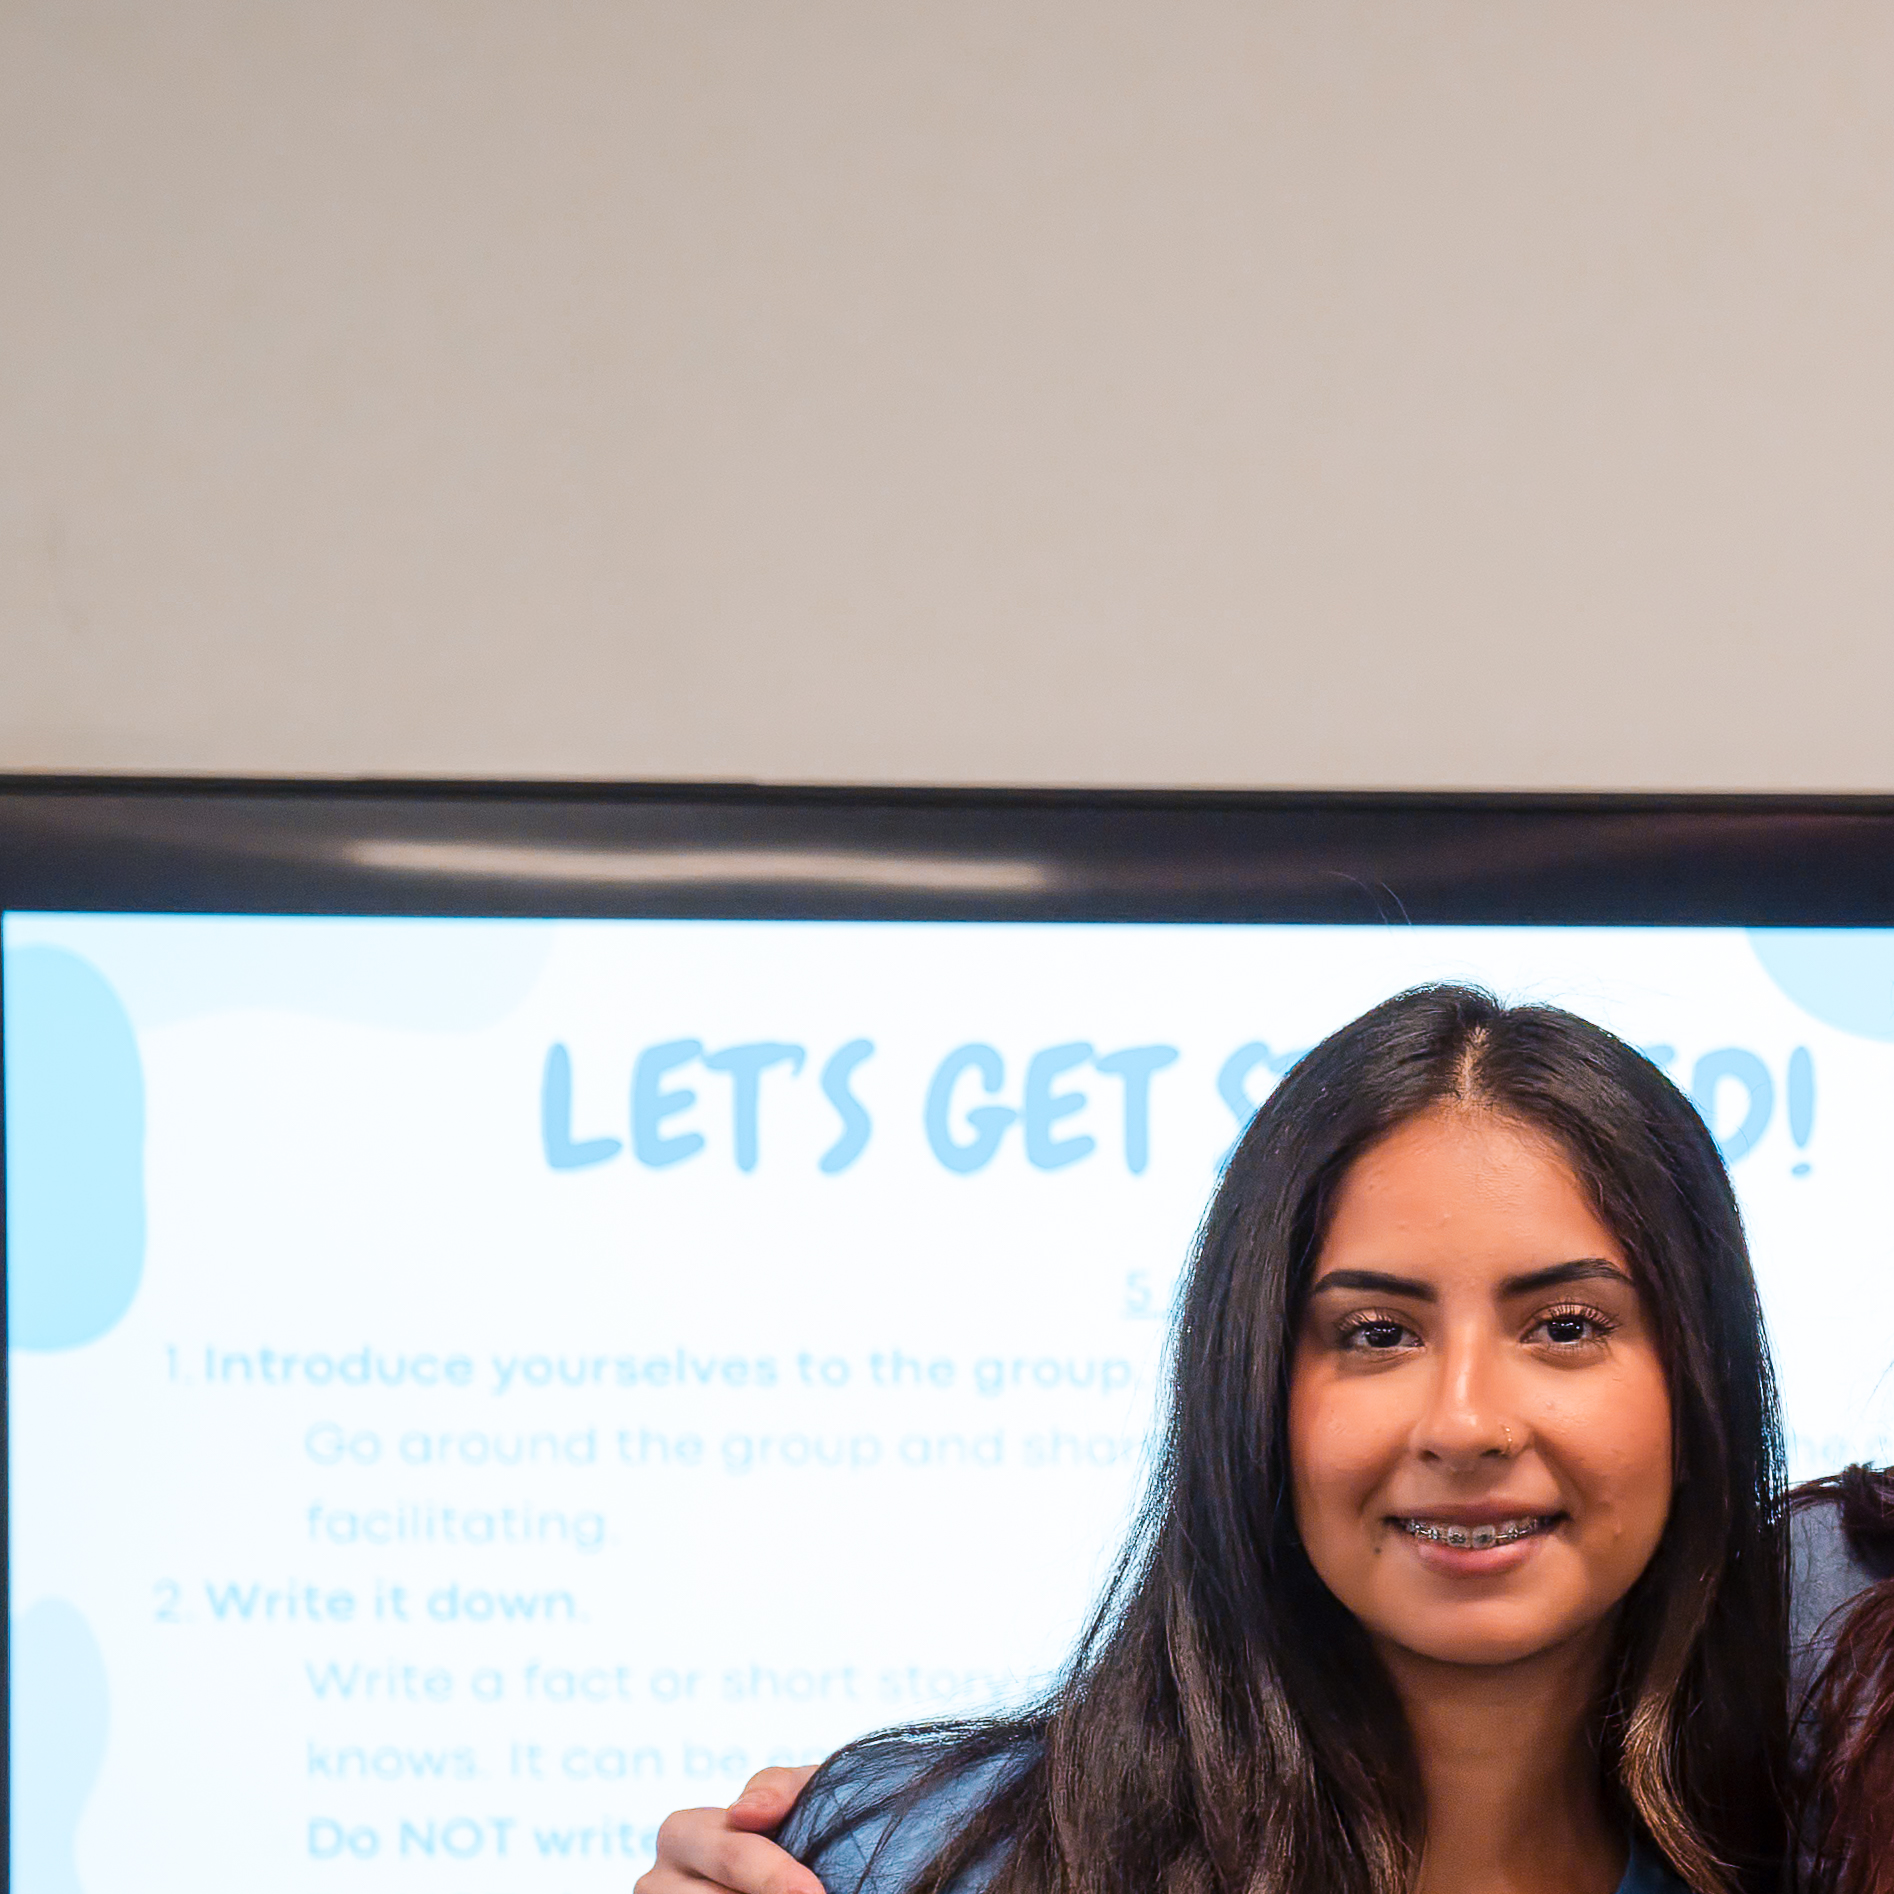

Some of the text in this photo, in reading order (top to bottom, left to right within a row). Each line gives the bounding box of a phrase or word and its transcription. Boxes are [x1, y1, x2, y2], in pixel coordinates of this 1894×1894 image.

[538, 1034, 878, 1179] LET'S
[921, 1038, 1183, 1179] GET
[203, 1341, 476, 1390] Introduce
[490, 1342, 780, 1399] yourselves
[794, 1347, 852, 1391] to
[866, 1343, 957, 1391] the
[302, 1420, 384, 1468] Go
[397, 1424, 600, 1468] around
[615, 1425, 706, 1468] the
[719, 1431, 885, 1478] group
[897, 1424, 1006, 1469] and
[205, 1577, 358, 1625] Write
[373, 1577, 412, 1625] it
[424, 1579, 591, 1625] down.
[303, 1657, 456, 1705] Write
[469, 1665, 507, 1705] a
[521, 1657, 632, 1705] fact
[649, 1665, 704, 1705] or
[721, 1659, 859, 1705] short
[509, 1740, 546, 1783] It
[560, 1745, 666, 1783] can
[682, 1737, 750, 1783] be
[305, 1815, 383, 1863] Do
[397, 1814, 520, 1863] NOT
